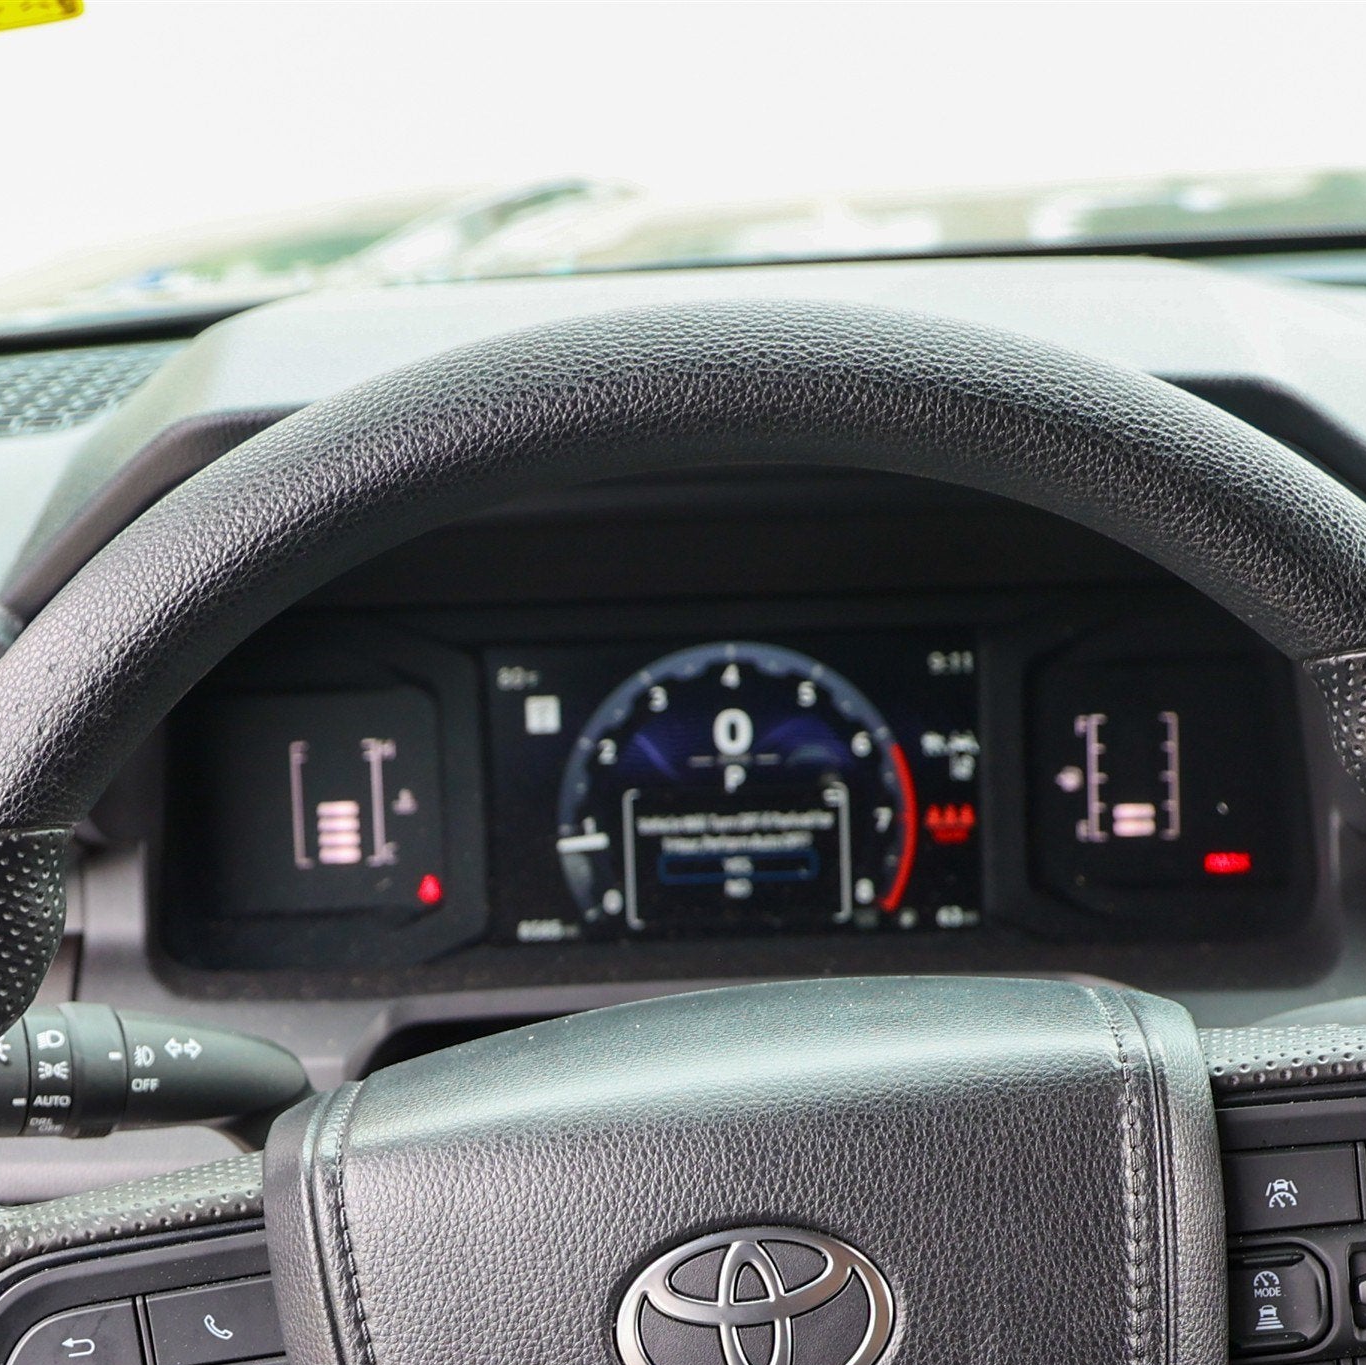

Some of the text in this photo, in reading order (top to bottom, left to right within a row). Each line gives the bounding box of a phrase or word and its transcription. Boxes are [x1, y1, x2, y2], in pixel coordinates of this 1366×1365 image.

[648, 685, 669, 713] 3
[713, 707, 754, 757] 0
[596, 738, 618, 766] 2
[724, 764, 747, 793] P
[131, 1078, 160, 1092] OFF
[33, 1094, 72, 1107] AUTO
[1253, 1286, 1282, 1298] MODE
